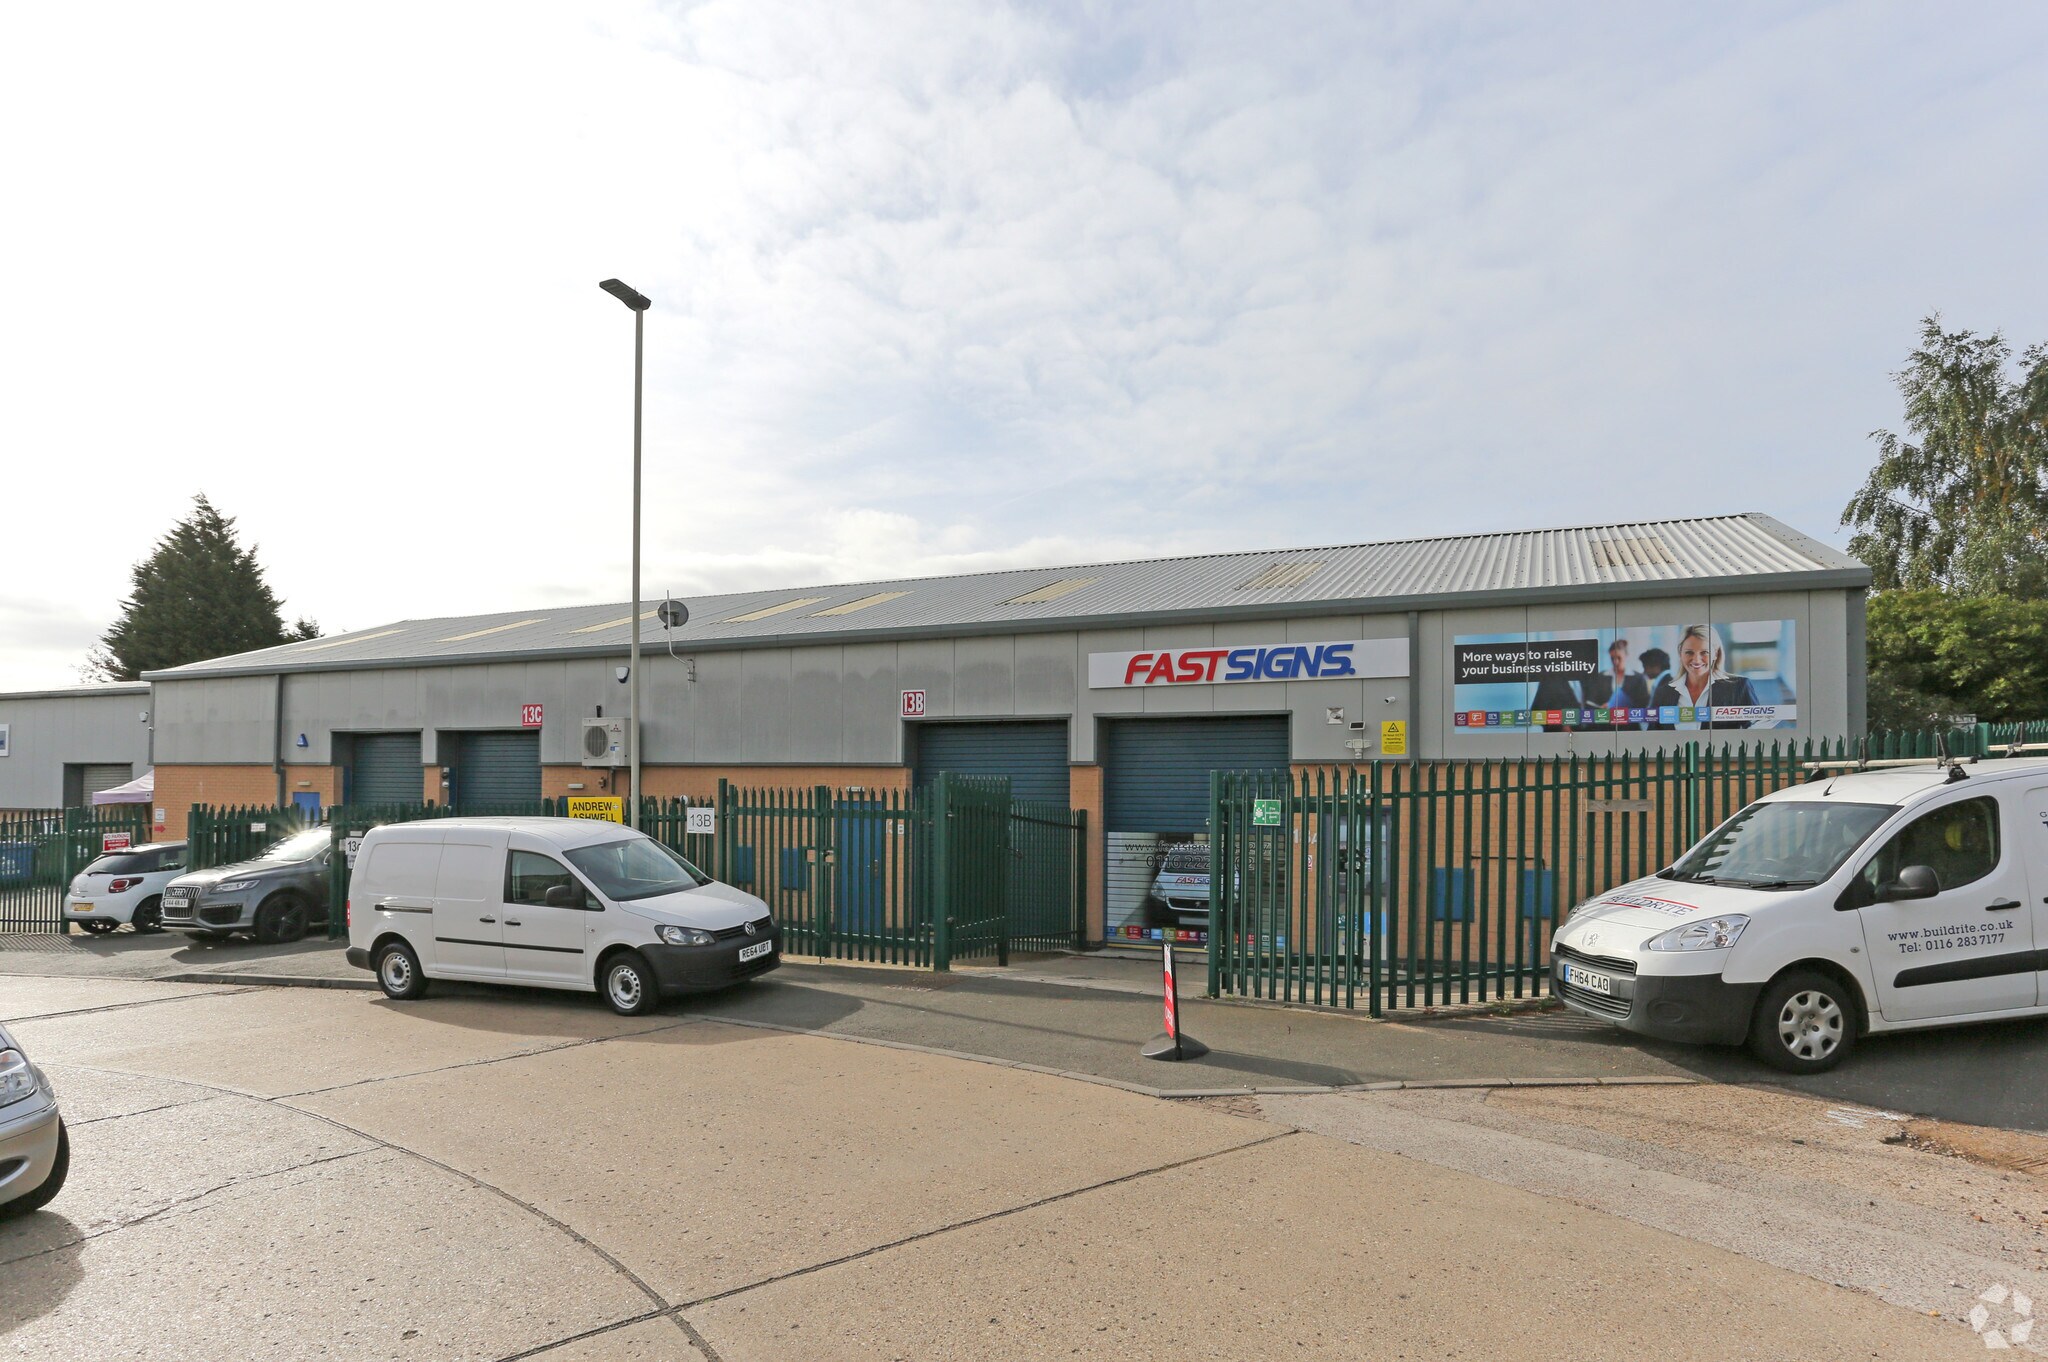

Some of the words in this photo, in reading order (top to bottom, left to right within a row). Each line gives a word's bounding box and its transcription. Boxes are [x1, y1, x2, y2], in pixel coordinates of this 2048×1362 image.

[1462, 652, 1492, 662] More
[1495, 651, 1525, 663] ways
[1528, 650, 1541, 660] to
[1544, 648, 1572, 659] raise
[1462, 666, 1489, 678] your
[1491, 663, 1541, 674] business
[1544, 660, 1596, 674] visibility
[903, 692, 924, 713] 13B
[523, 705, 542, 723] 13C
[1715, 706, 1775, 716] FASTSIGNS
[572, 802, 612, 812] ANDREW
[690, 814, 712, 827] 13B
[1146, 855, 1180, 869] 0116
[1888, 919, 2014, 942] www.buildrite.co.uk
[1899, 942, 1922, 954] Tel:
[1925, 938, 1953, 951] 0116
[1569, 968, 1589, 986] FH64
